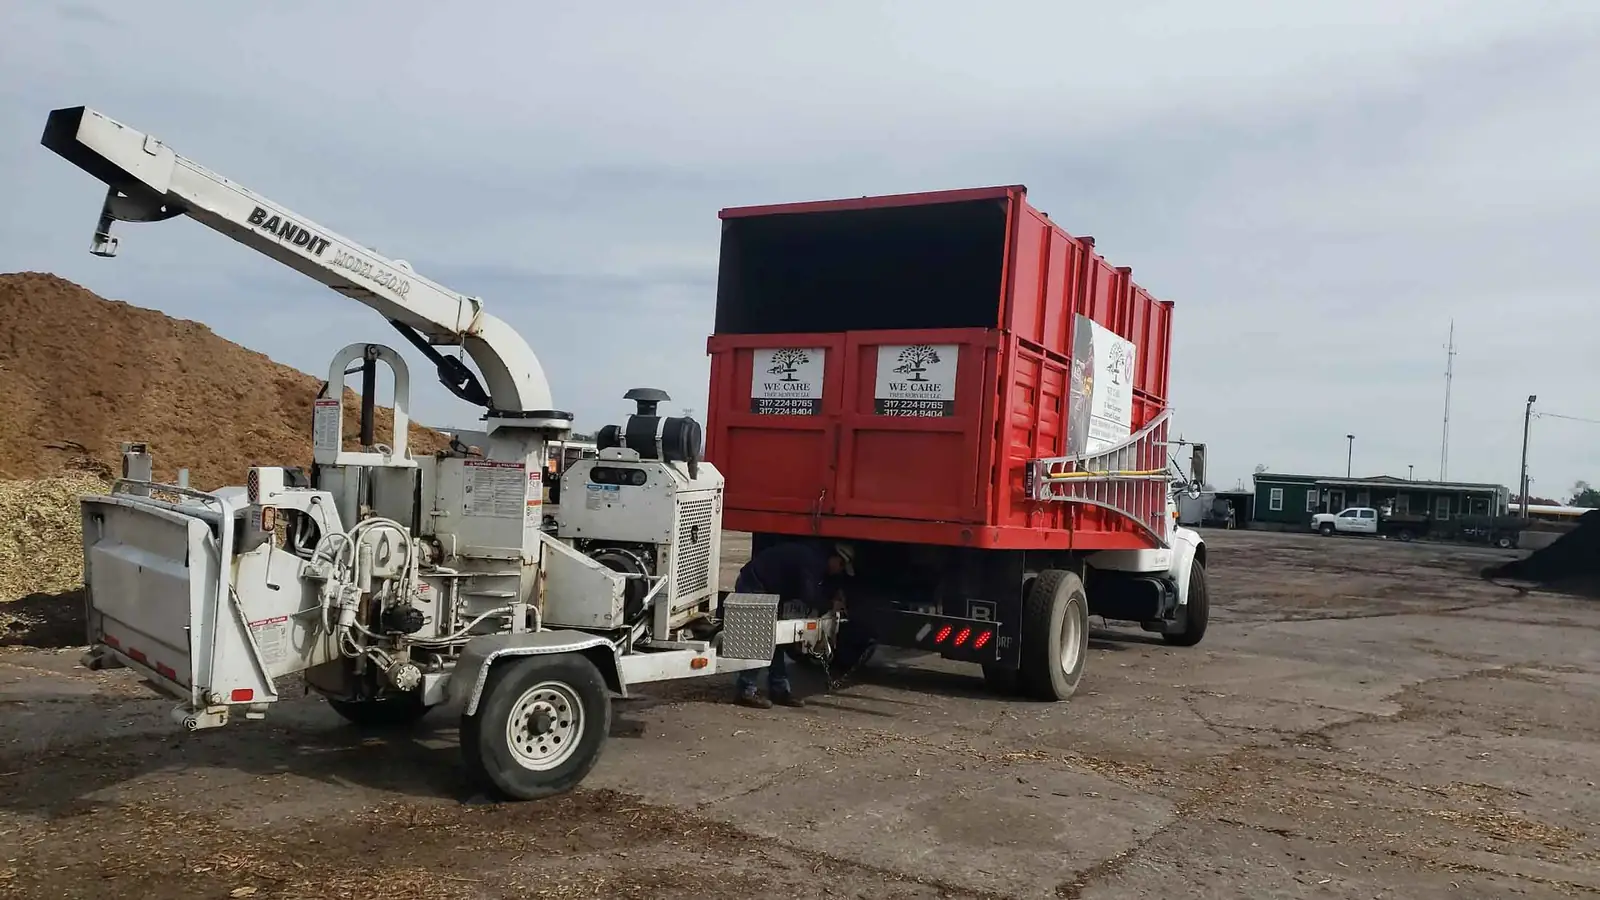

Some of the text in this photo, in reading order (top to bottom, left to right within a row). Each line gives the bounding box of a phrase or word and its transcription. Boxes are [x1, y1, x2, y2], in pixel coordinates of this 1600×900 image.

[247, 206, 331, 258] BANDIT
[332, 249, 374, 280] MODEL
[764, 382, 811, 392] WE CARE
[889, 382, 942, 392] WE CARE
[759, 399, 813, 407] 317-224-8765
[883, 400, 944, 409] 317-224-8765
[759, 407, 812, 415] 317-224-9404
[883, 408, 943, 417] 317-224-9404
